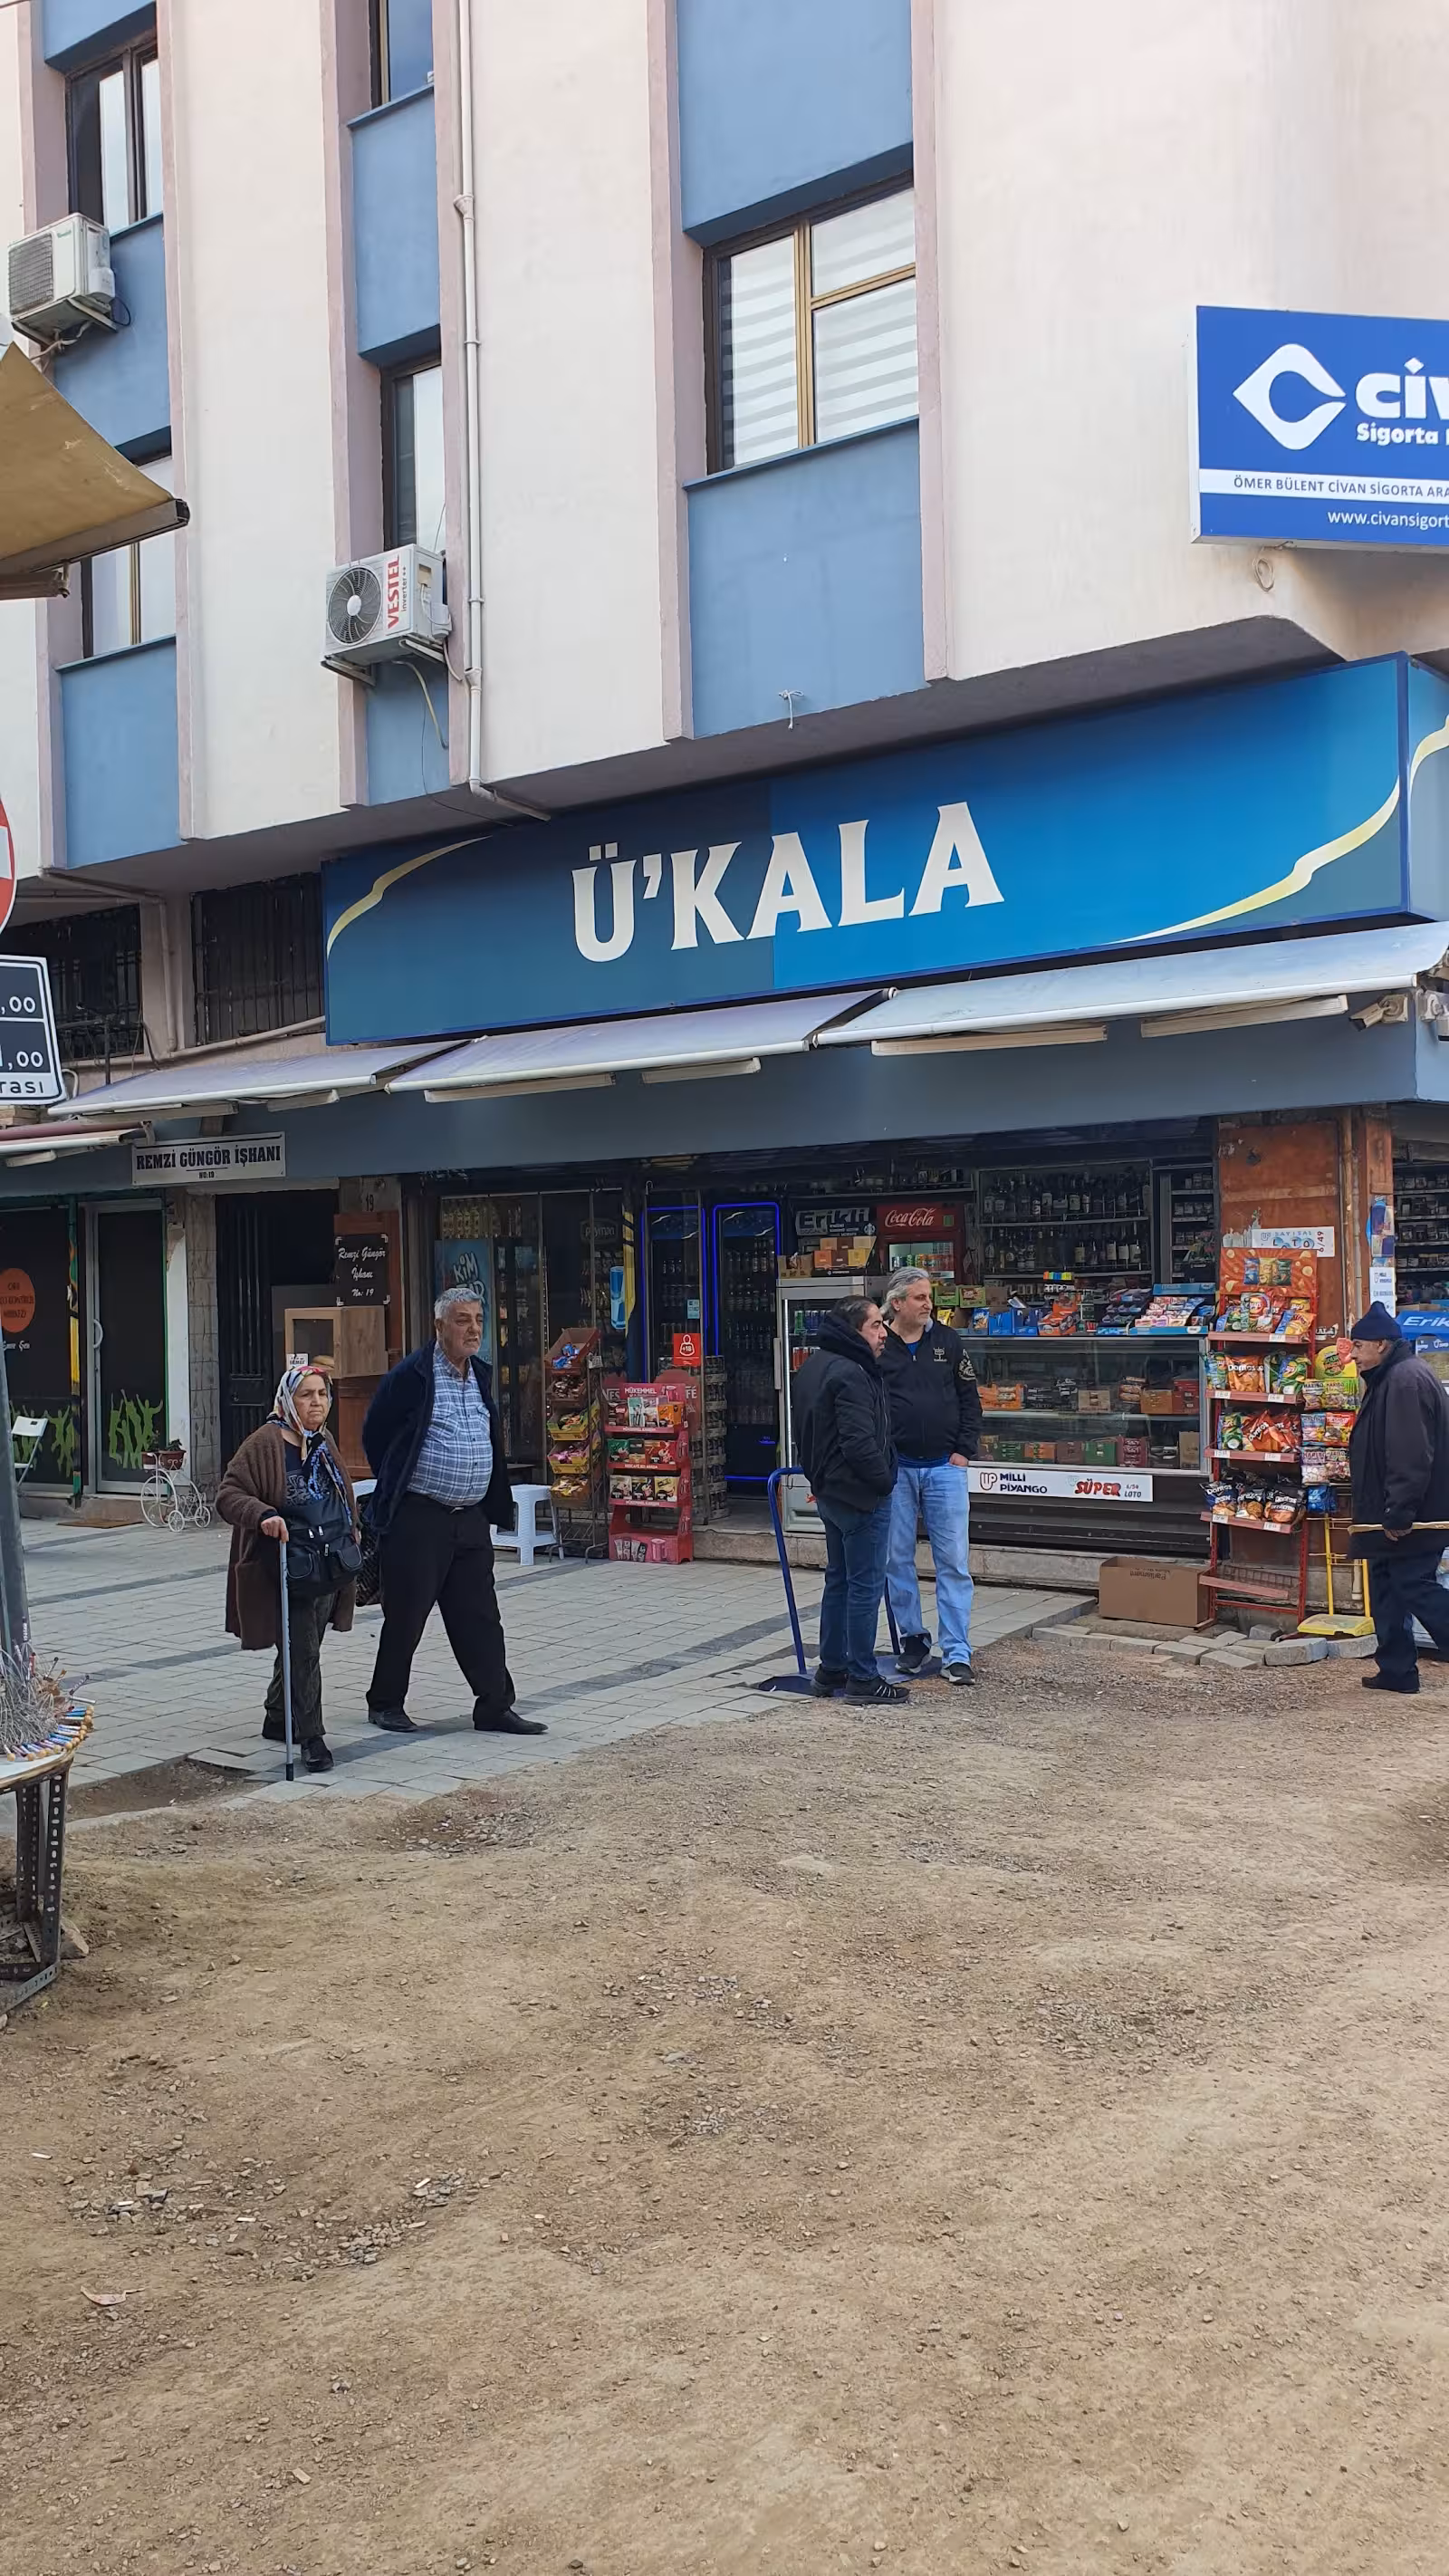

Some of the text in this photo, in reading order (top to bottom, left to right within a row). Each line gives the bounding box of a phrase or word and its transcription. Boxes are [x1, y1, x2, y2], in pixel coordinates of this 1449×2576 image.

[1357, 421, 1439, 446] Sigorta
[1233, 475, 1271, 490] ÖMER
[1276, 476, 1324, 493] BÜLENT
[1328, 478, 1366, 495] CİVAN
[1369, 480, 1424, 497] SİGORTA
[387, 553, 400, 629] VESTEL
[571, 802, 1005, 962] Ü'KALA
[137, 1144, 281, 1170] REMZİ GÜNGÖR İŞHANI
[365, 1194, 374, 1212] 19
[338, 1246, 386, 1262] Remzi Güngör
[365, 1288, 374, 1296] 19
[624, 1386, 657, 1395] MÜKEMMEL
[1000, 1472, 1026, 1482] MİLLİ
[1000, 1484, 1048, 1494] PİYANGO
[1075, 1478, 1121, 1497] SÜPER
